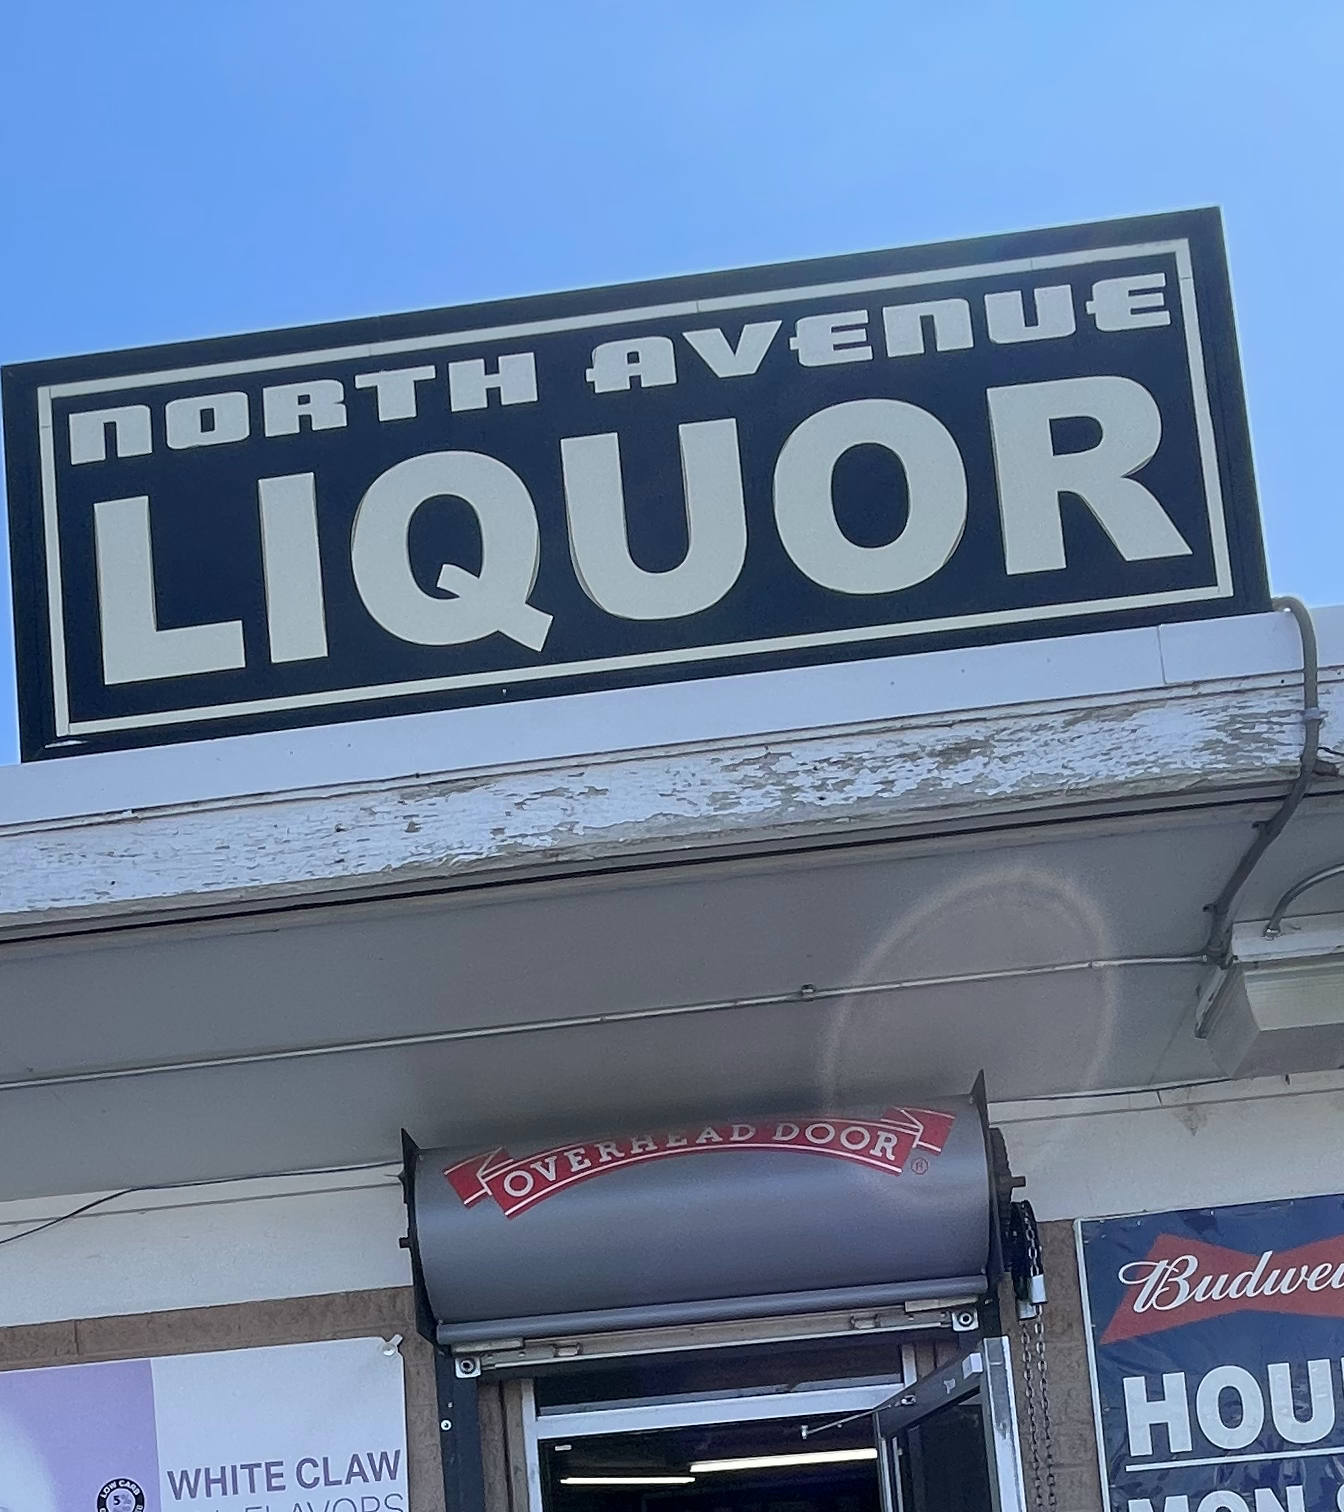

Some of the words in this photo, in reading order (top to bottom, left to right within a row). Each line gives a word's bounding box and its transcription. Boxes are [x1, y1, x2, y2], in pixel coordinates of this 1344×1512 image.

[69, 354, 538, 465] NORTH
[585, 272, 1172, 393] AVENUE
[93, 375, 1193, 686] LIQUOR
[503, 1123, 755, 1198] OVERHEAD
[772, 1122, 899, 1161] DOOR
[166, 1460, 286, 1501] WHITE
[295, 1449, 401, 1490] CLAW
